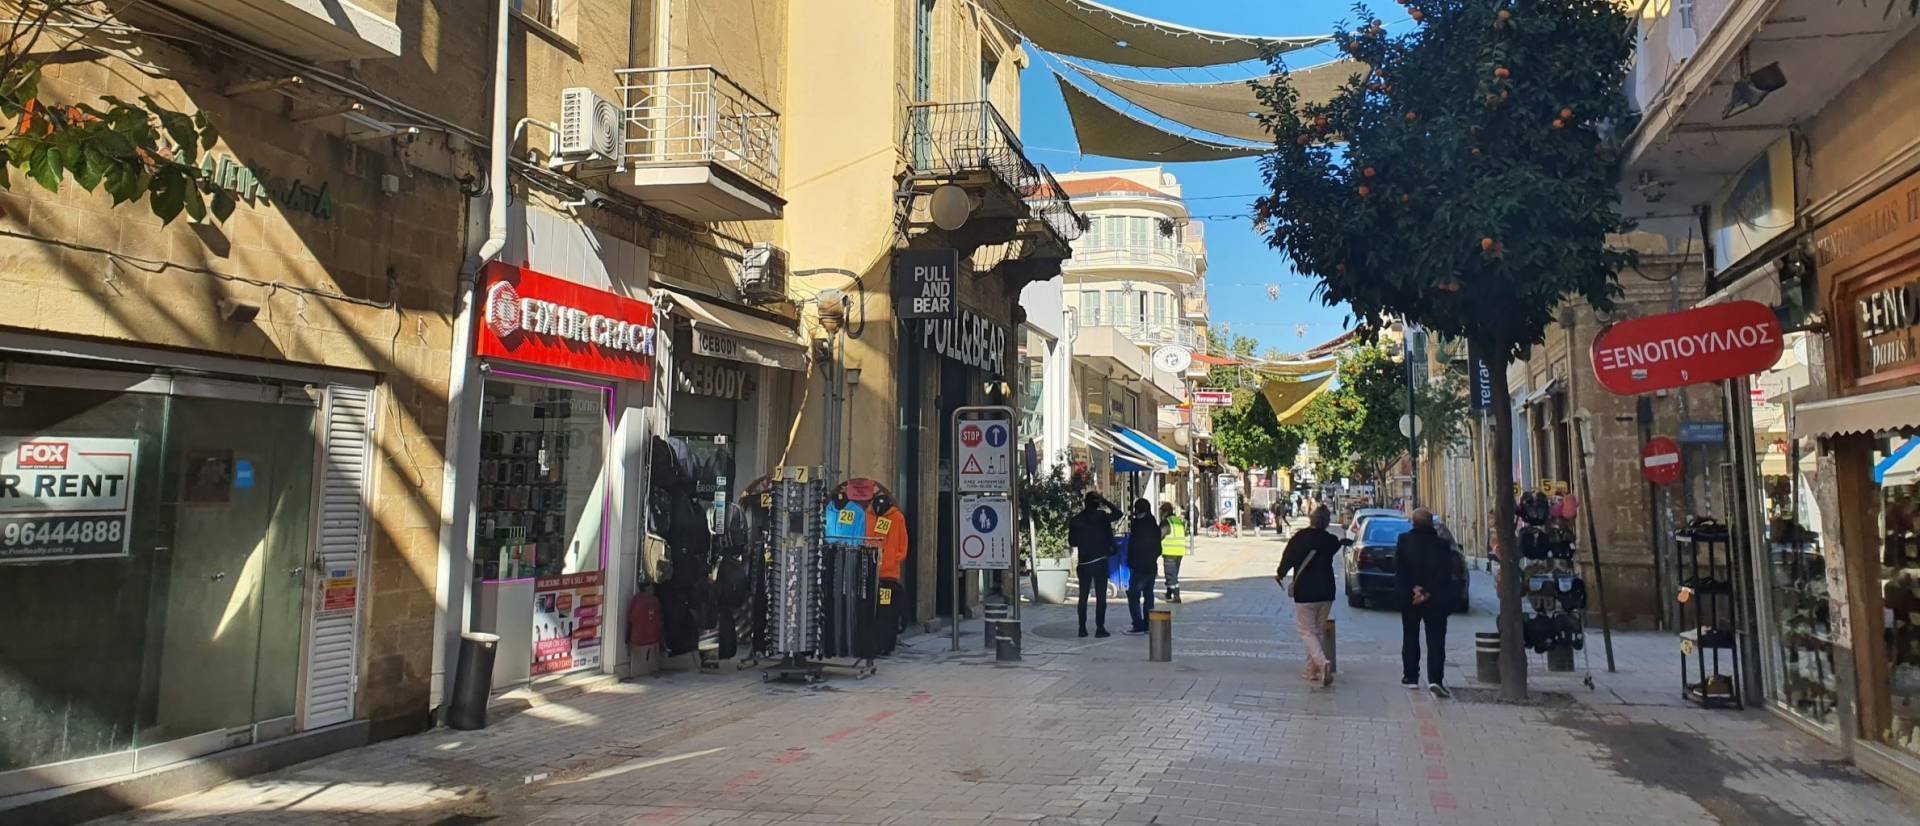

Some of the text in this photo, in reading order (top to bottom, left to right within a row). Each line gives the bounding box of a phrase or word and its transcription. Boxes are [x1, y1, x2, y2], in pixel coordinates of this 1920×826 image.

[914, 265, 950, 281] PULL
[921, 281, 950, 297] AND
[913, 297, 950, 313] BEAR
[591, 314, 656, 357] CRACK
[923, 309, 1005, 376] PULL&BEAR
[1600, 313, 1774, 370] ΞΕΝΟΠΟΥΛΛΟΣ
[962, 431, 980, 441] STOP
[20, 444, 67, 463] FOX
[797, 468, 804, 480] 7
[34, 474, 124, 497] RENT
[1543, 480, 1552, 491] 5
[841, 511, 854, 522] 28
[4, 521, 121, 546] 96444888
[876, 520, 889, 532] 28
[880, 590, 890, 601] 28
